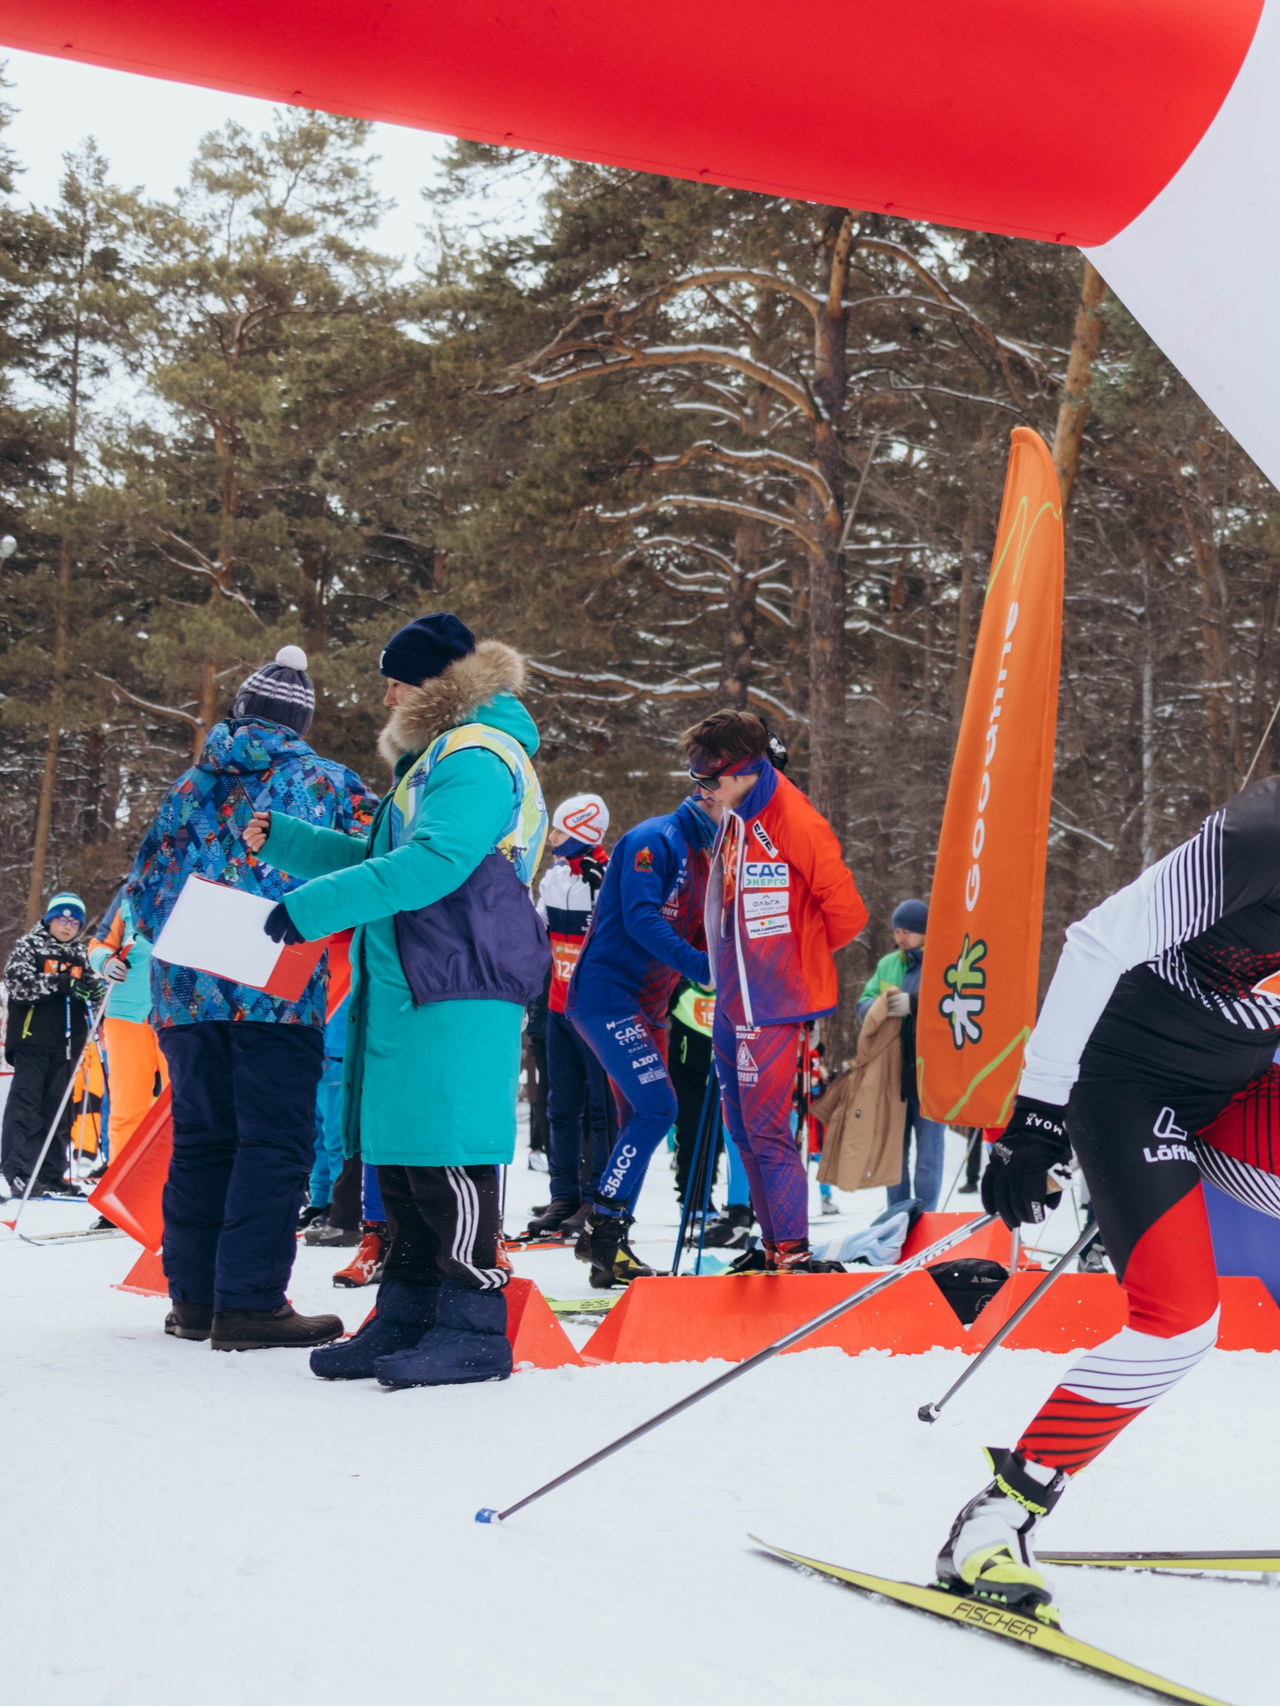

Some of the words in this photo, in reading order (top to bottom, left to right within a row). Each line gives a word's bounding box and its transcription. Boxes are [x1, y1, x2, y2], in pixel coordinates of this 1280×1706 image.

[746, 864, 787, 878] СДС
[752, 899, 780, 908] ОЛЬГА
[614, 1024, 645, 1040] СДС
[632, 1053, 659, 1070] АЗОТ
[1025, 1116, 1063, 1136] MOAX
[952, 1602, 1039, 1640] FISCHER
